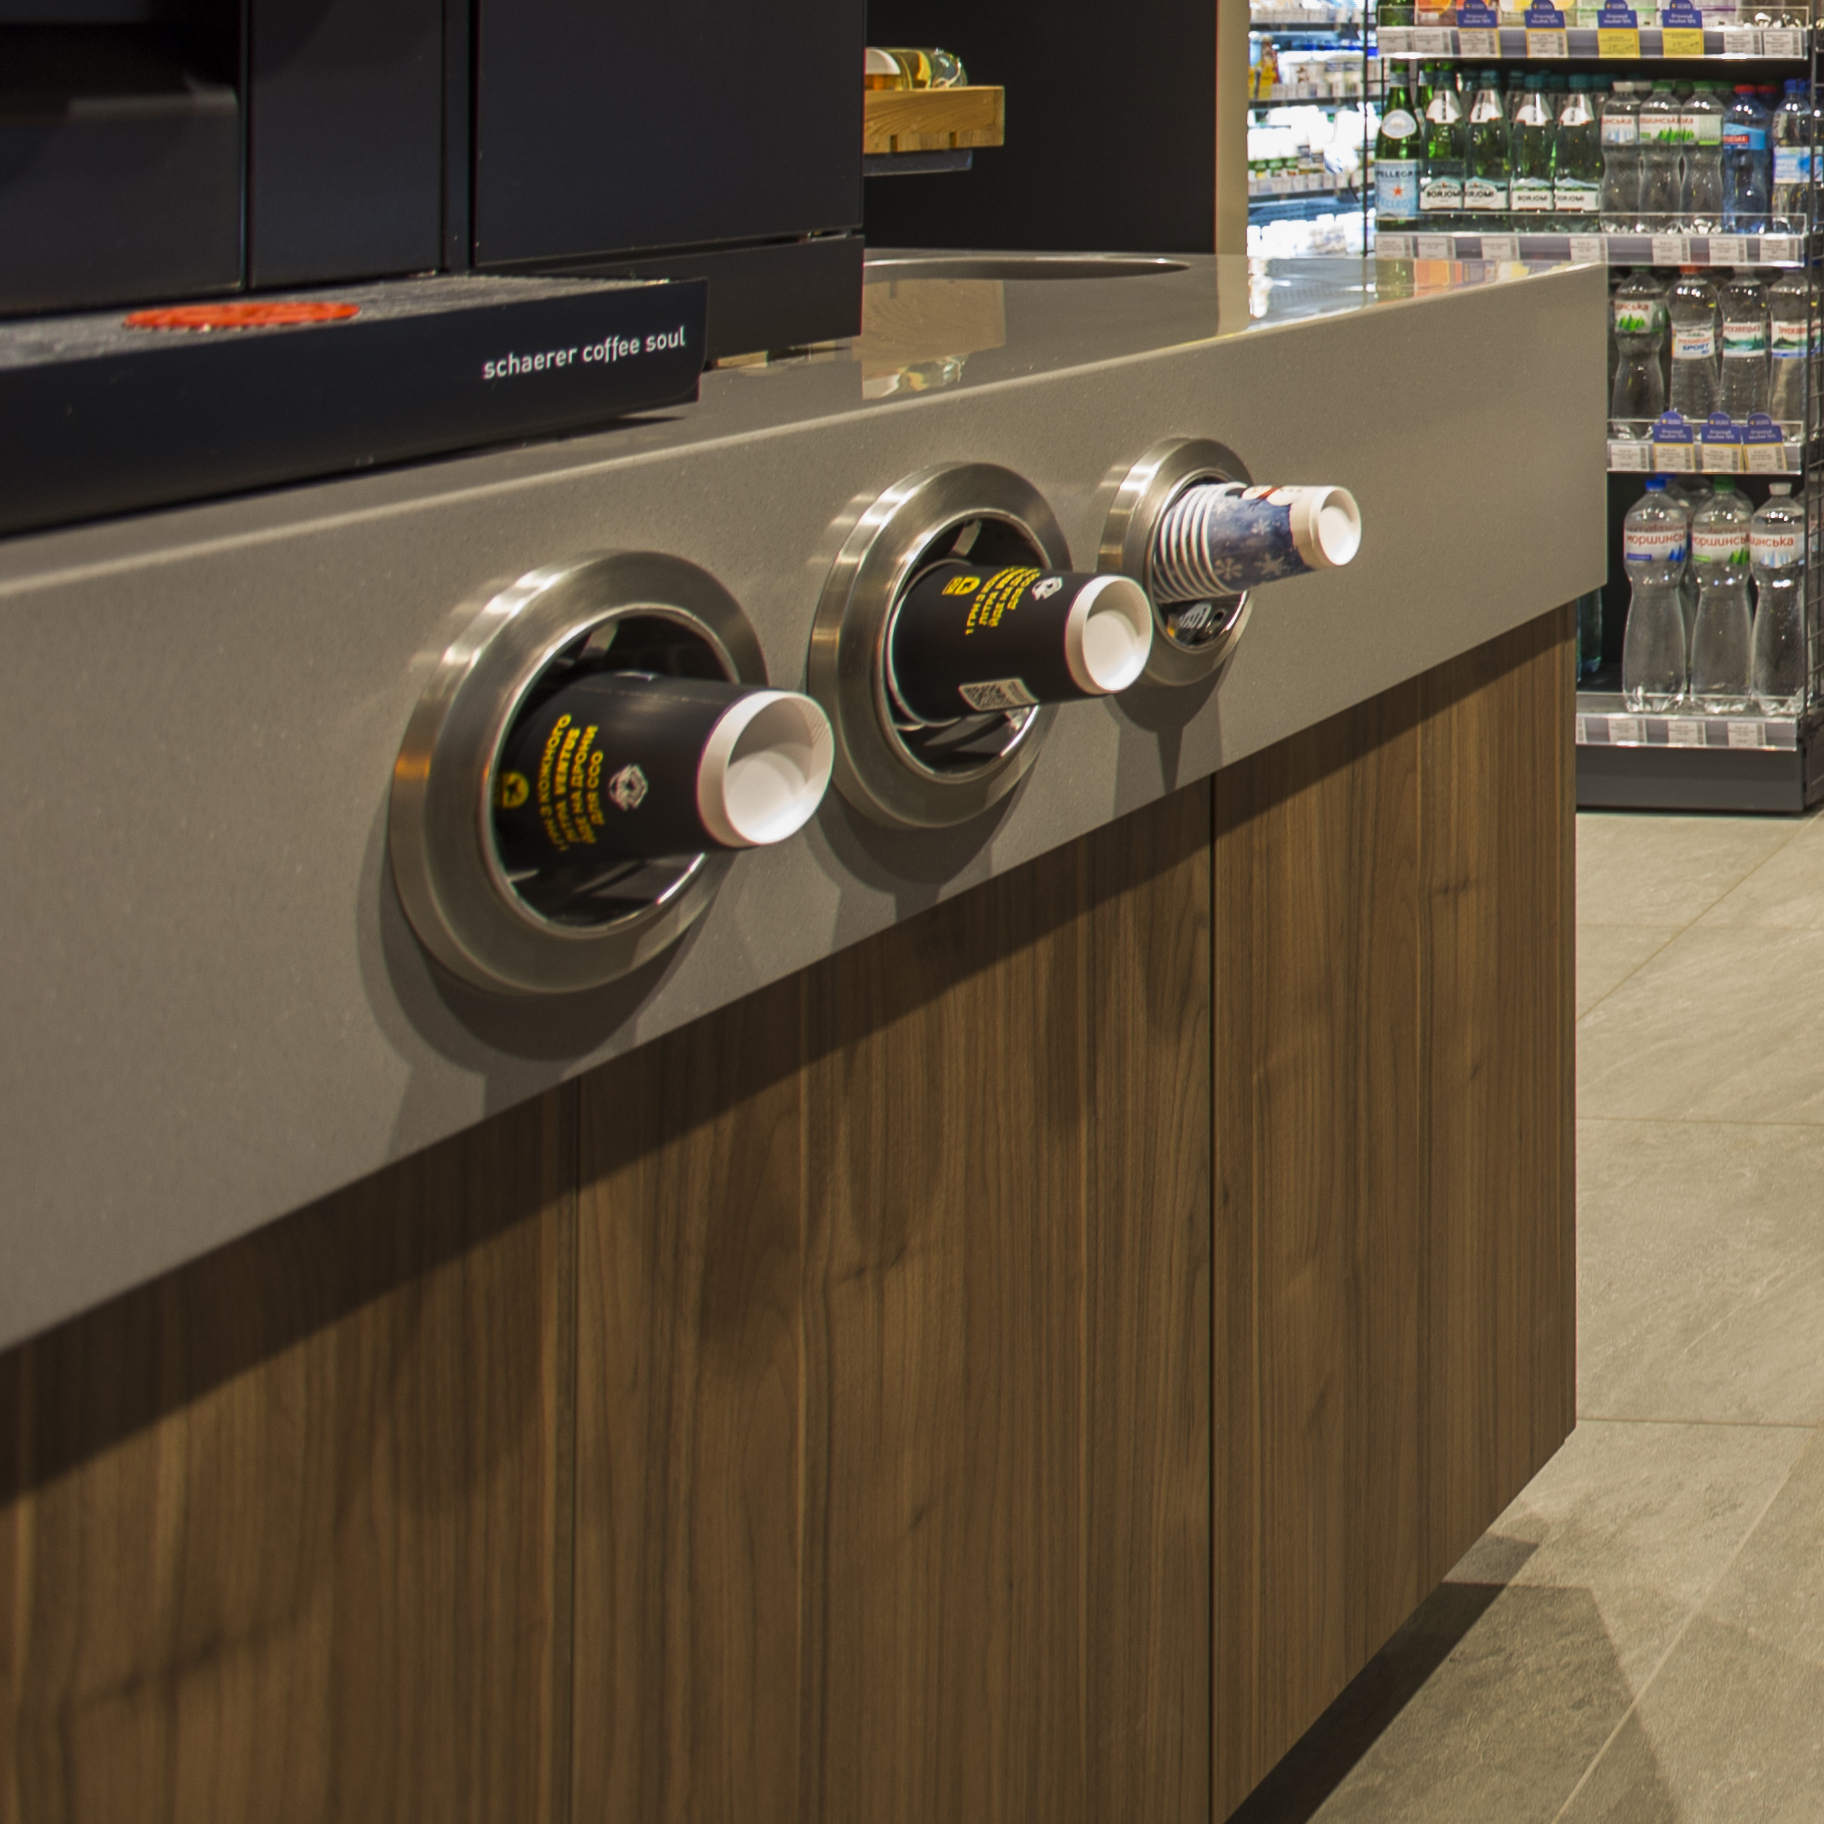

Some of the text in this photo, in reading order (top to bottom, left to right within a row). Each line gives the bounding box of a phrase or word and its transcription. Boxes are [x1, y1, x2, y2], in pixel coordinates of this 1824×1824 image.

[483, 327, 686, 380] schaerer coffee soul
[537, 713, 572, 803] КОЖНОГО
[554, 727, 581, 795] VENTUS
[571, 724, 599, 787] ДРОНИ
[571, 790, 584, 814] НА
[587, 791, 605, 825] ДЛЯ
